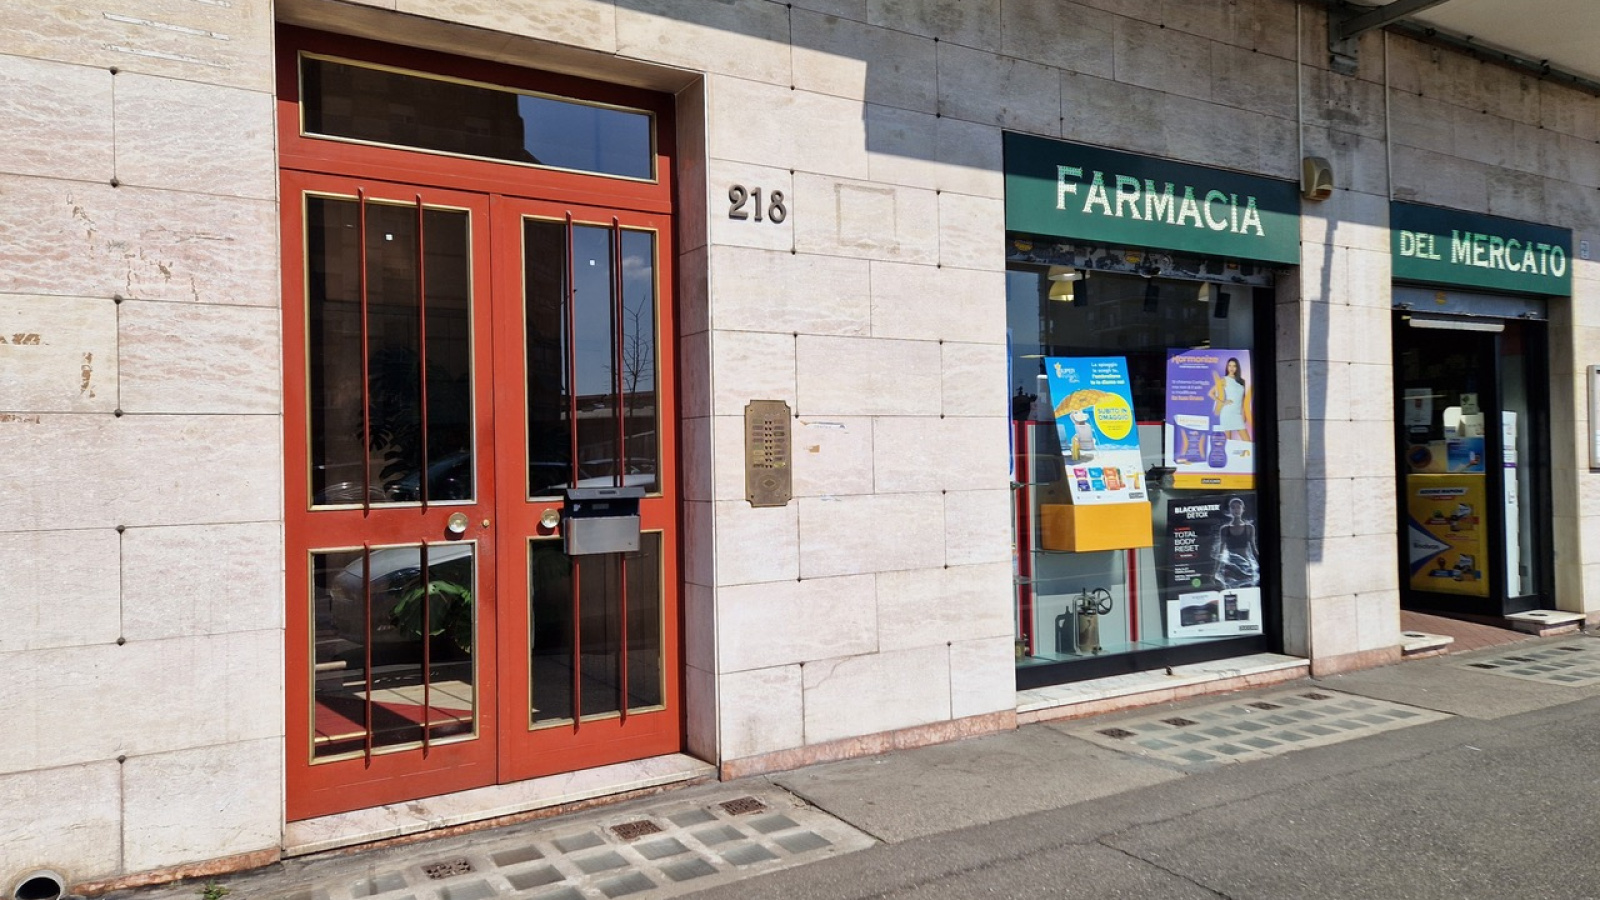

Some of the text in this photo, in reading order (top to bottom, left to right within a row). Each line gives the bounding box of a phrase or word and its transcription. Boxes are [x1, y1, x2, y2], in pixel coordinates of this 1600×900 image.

[729, 184, 787, 224] 218
[1056, 165, 1265, 236] FARMACIA
[1400, 230, 1441, 261] DEL
[1451, 230, 1566, 277] MERCATO
[1175, 504, 1220, 514] BLACKWATER
[1186, 511, 1209, 519] DETOX
[1174, 530, 1198, 538] TOTAL
[1175, 538, 1195, 546] BODY
